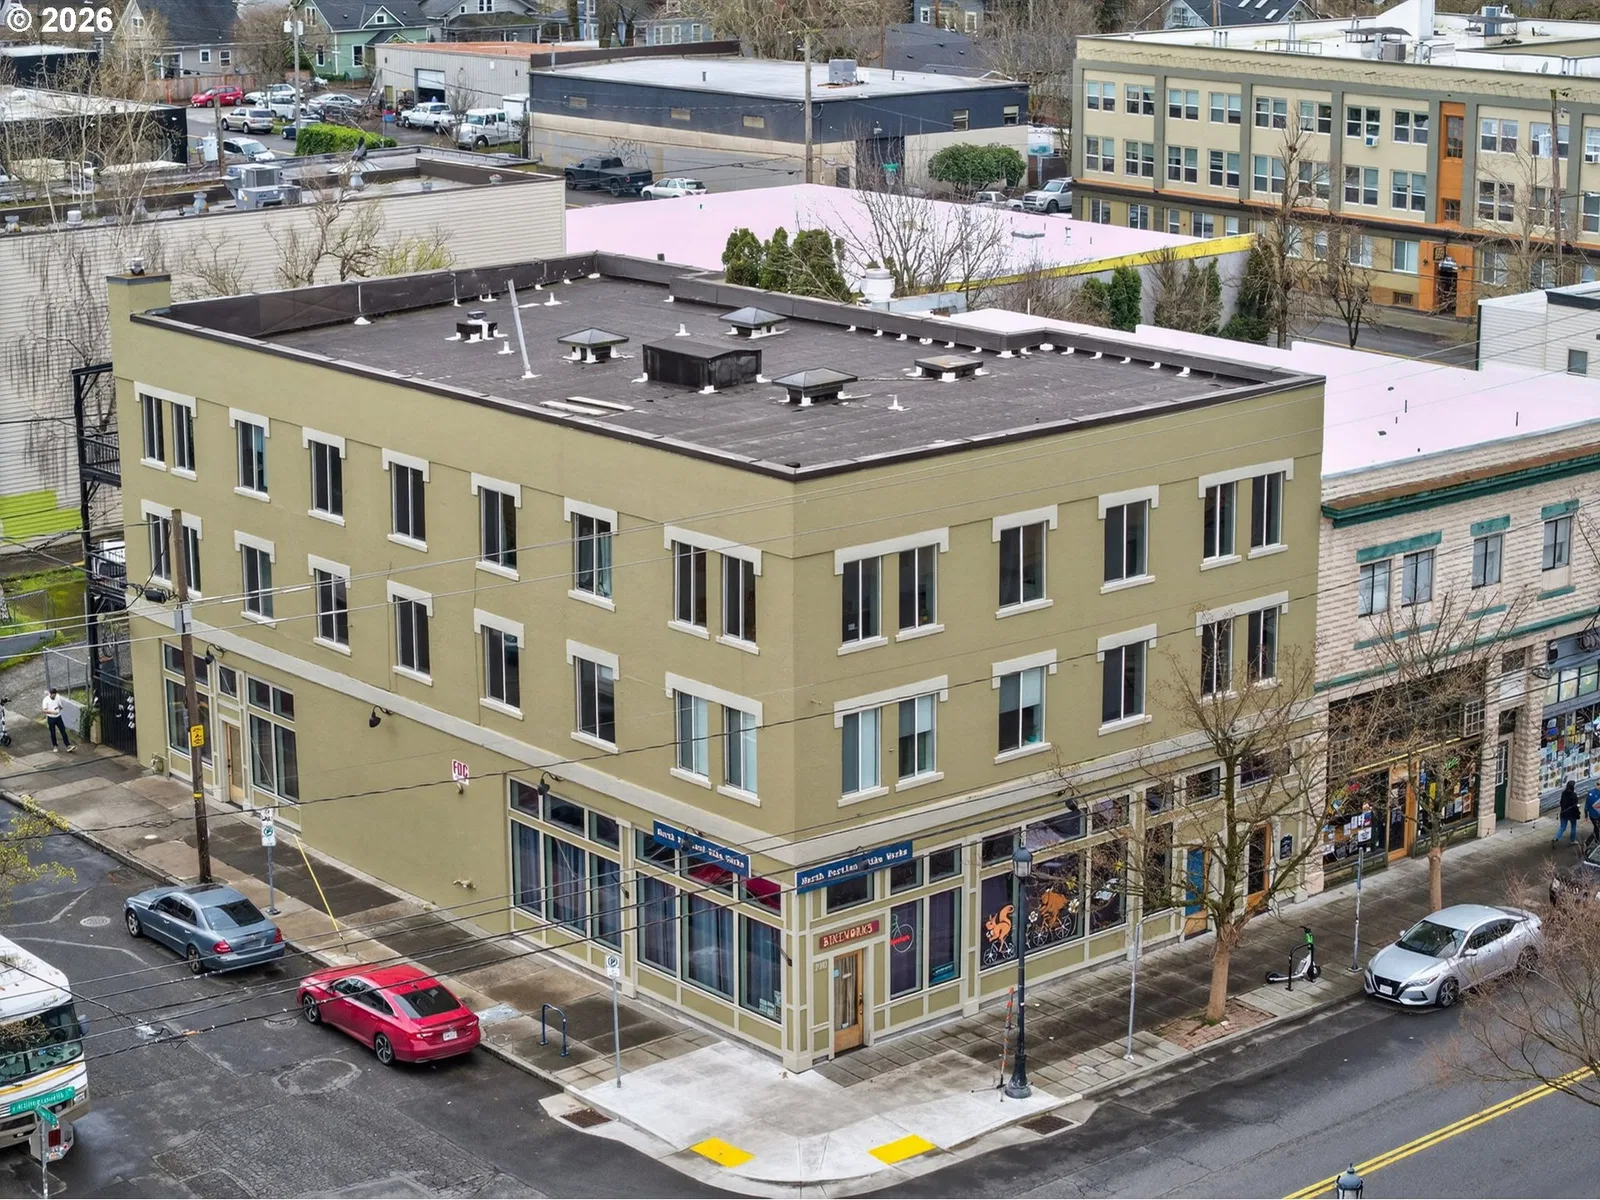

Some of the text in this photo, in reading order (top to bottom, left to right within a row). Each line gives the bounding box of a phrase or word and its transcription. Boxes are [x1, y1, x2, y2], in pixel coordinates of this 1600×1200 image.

[801, 872, 824, 885] North
[827, 863, 858, 877] Portlan
[886, 848, 908, 860] Works
